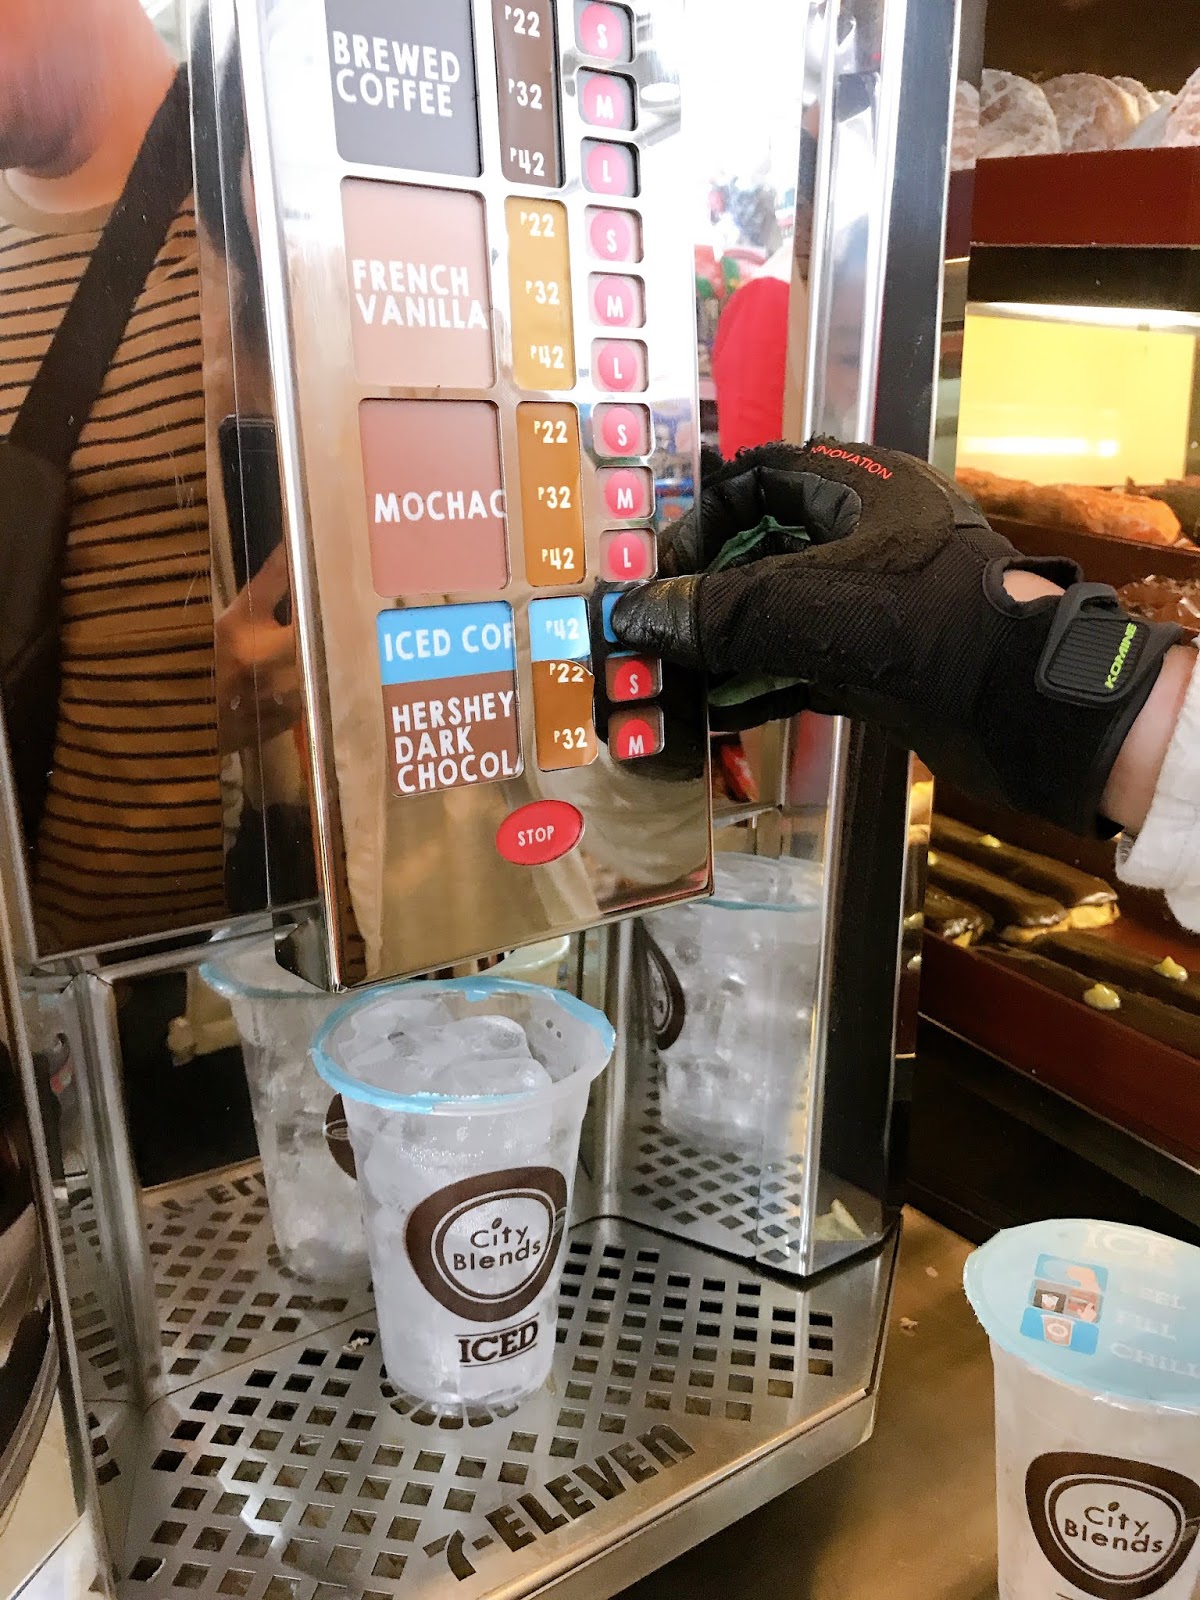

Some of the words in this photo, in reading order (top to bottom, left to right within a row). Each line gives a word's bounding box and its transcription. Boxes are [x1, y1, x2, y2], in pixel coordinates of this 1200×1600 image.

[597, 23, 609, 50] S
[332, 31, 460, 84] BREWED
[336, 69, 453, 118] COFFEE
[596, 94, 614, 120] M
[602, 160, 612, 183] L
[606, 230, 617, 254] S
[352, 259, 470, 298] FRENCH
[354, 293, 488, 331] VANILLA
[607, 296, 624, 318] M
[613, 357, 623, 379] L
[617, 423, 627, 447] S
[617, 487, 634, 510] M
[623, 547, 632, 568] L
[384, 628, 451, 662] ICED
[1104, 622, 1138, 689] KOMINE
[629, 673, 639, 695] S
[392, 690, 514, 734] HERSHEY
[395, 726, 474, 764] DARK
[628, 734, 645, 757] M
[397, 750, 520, 793] CHOCOL
[517, 825, 555, 846] STOP
[470, 1217, 529, 1249] City
[453, 1239, 541, 1271] Blends
[458, 1320, 539, 1363] ICED
[1084, 1501, 1149, 1537] City
[1064, 1518, 1163, 1553] Blends
